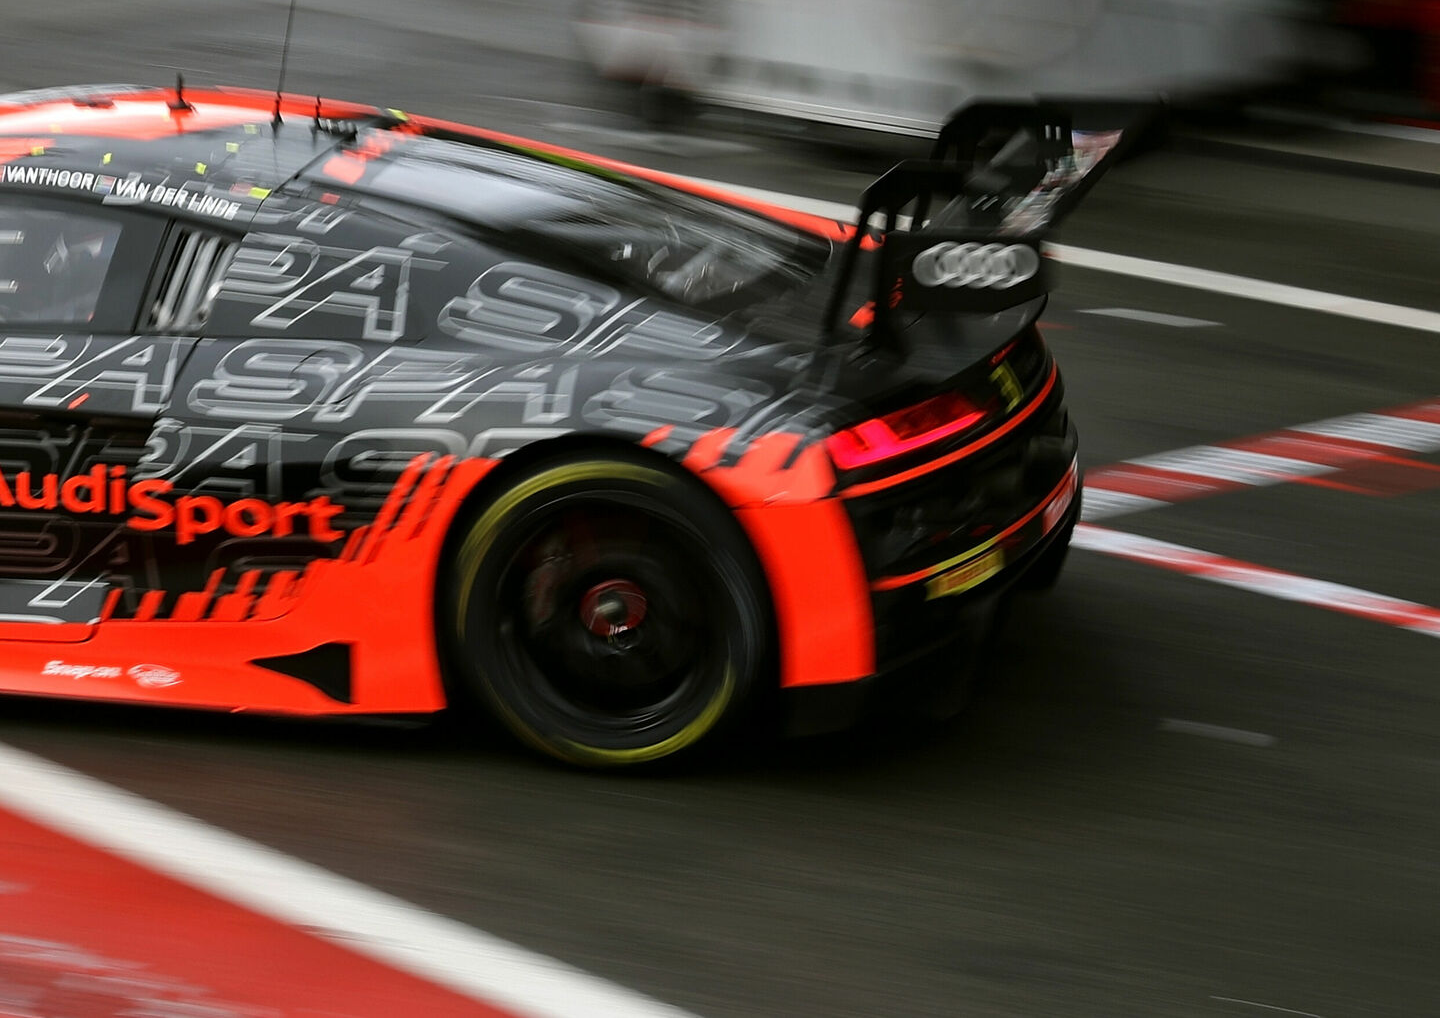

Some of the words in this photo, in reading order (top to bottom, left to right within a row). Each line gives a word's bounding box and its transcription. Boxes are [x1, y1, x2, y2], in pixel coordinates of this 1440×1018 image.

[7, 165, 95, 191] VANTHOOR
[115, 177, 151, 201] VAN
[149, 184, 189, 208] DER
[186, 191, 242, 221] LINDE
